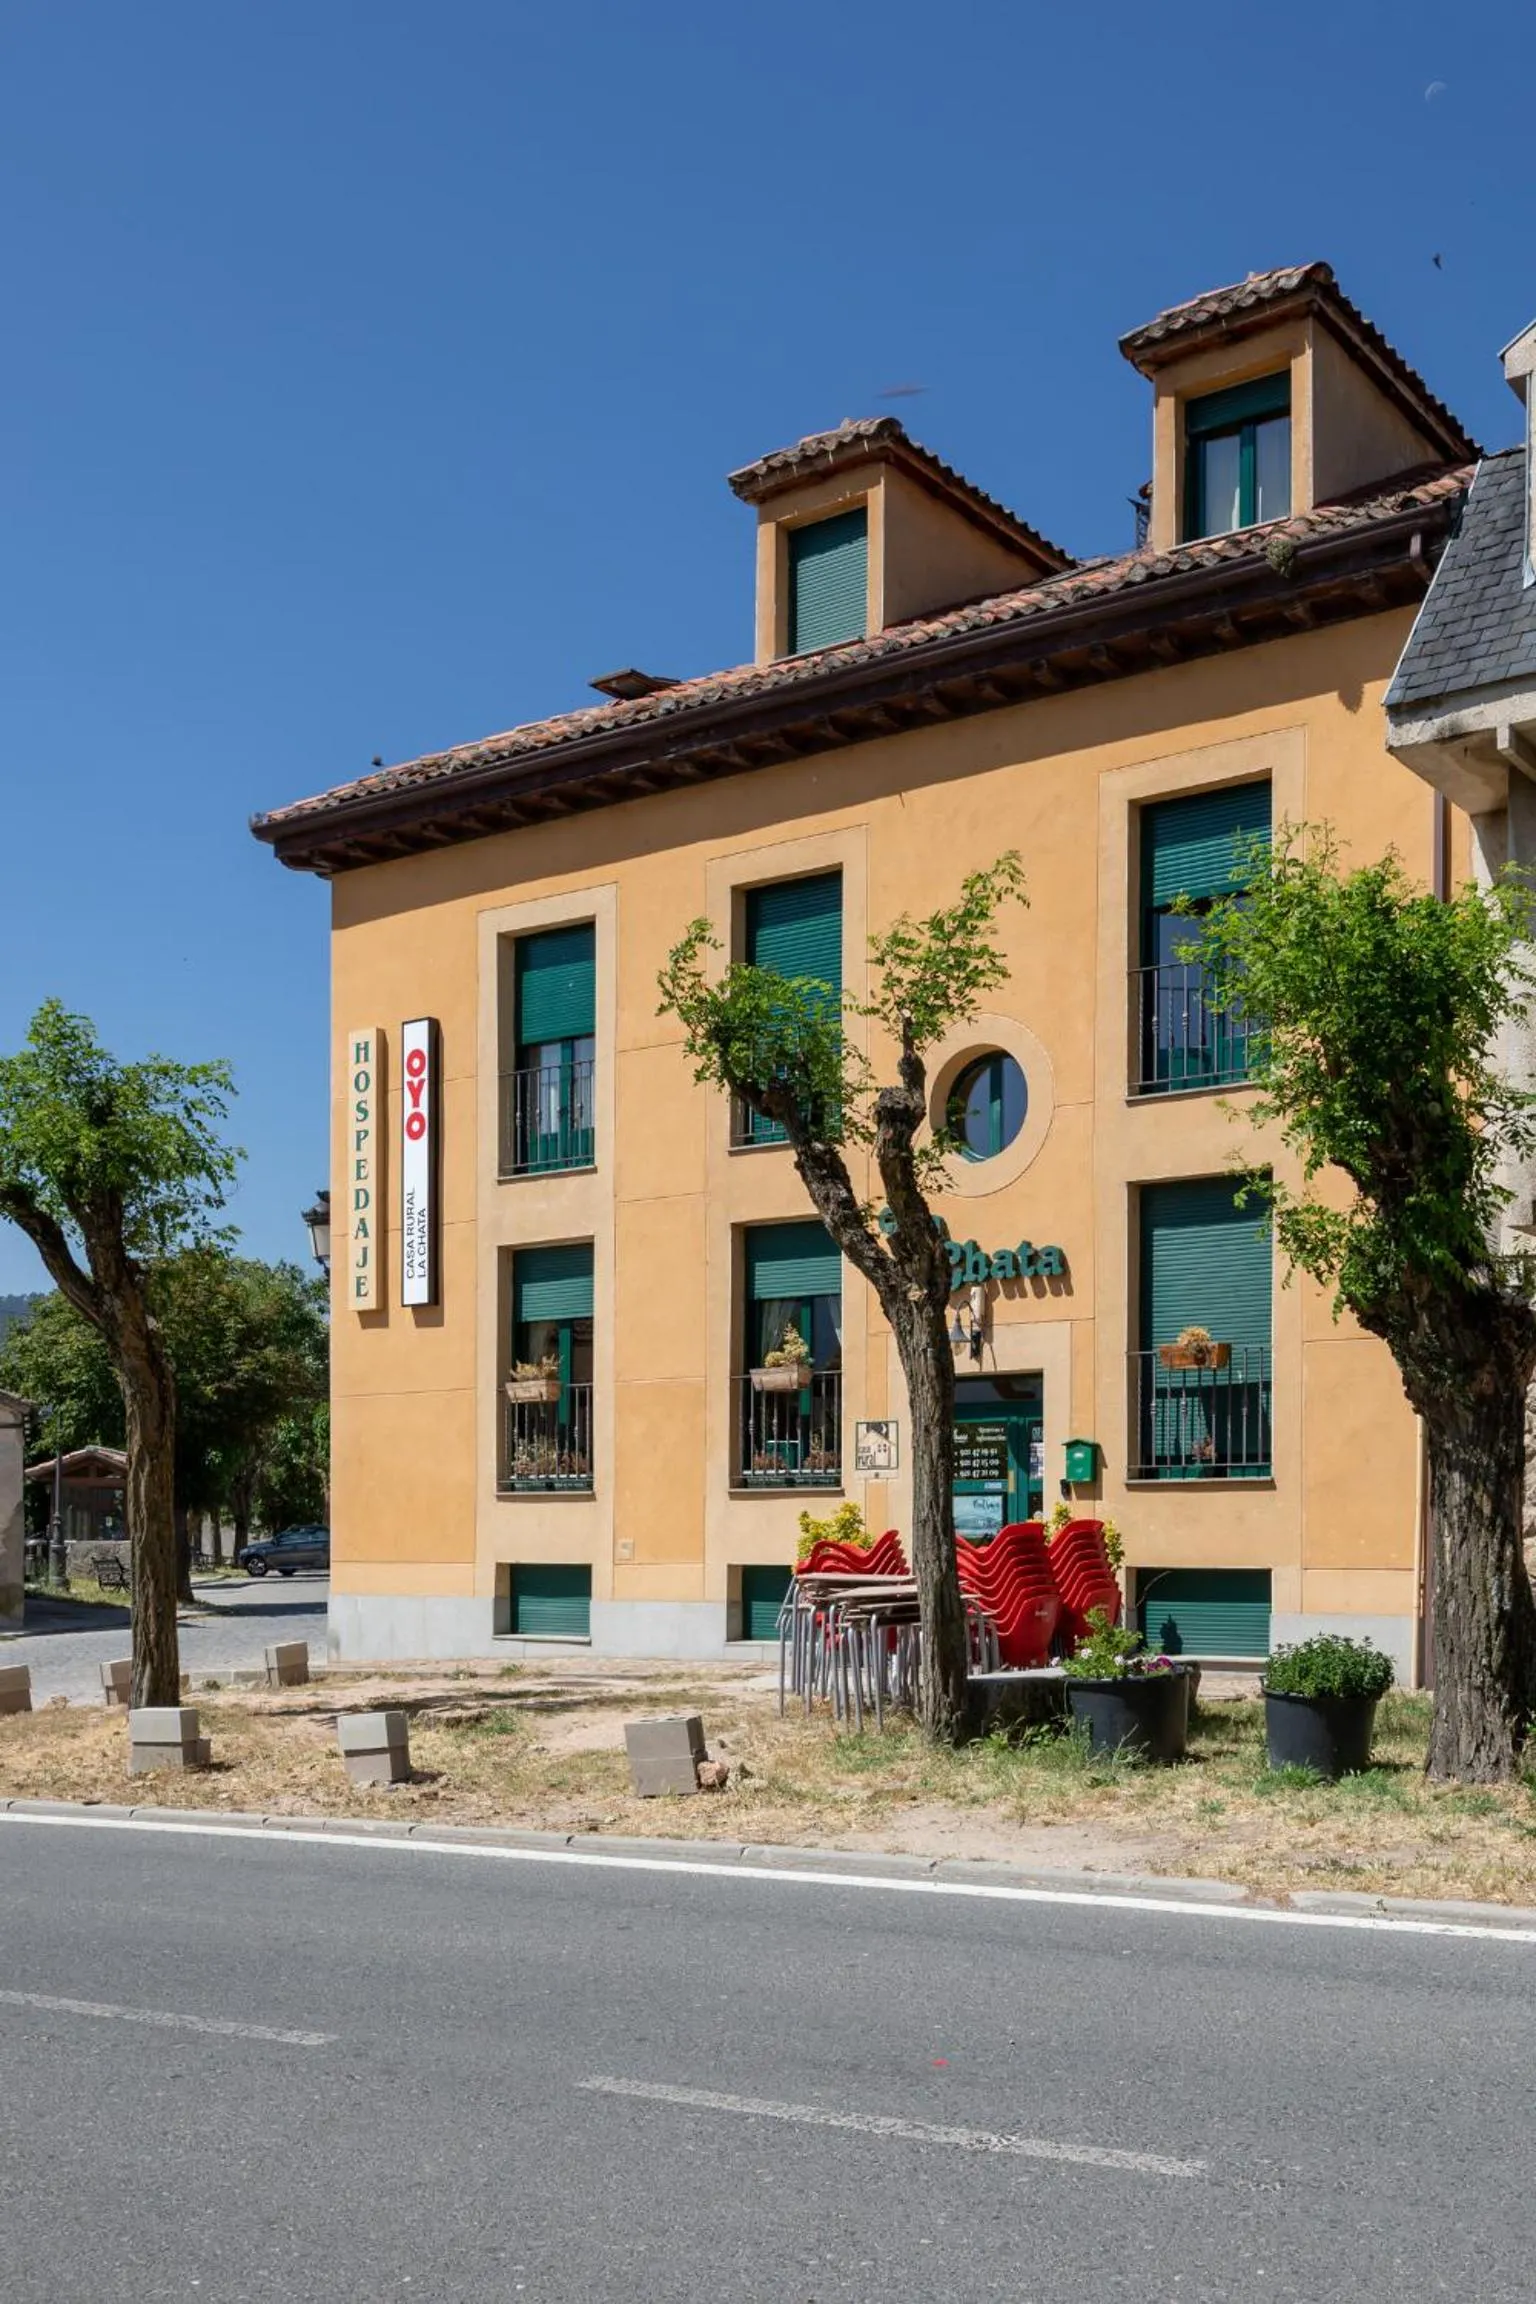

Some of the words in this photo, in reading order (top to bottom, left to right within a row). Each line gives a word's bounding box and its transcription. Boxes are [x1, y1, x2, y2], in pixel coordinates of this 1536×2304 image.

[406, 1048, 426, 1140] OYO
[354, 1040, 371, 1298] HOSPEDAJE
[406, 1186, 415, 1236] RURAL
[417, 1208, 426, 1256] CHATA
[406, 1239, 415, 1280] CASA
[417, 1259, 426, 1279] LA
